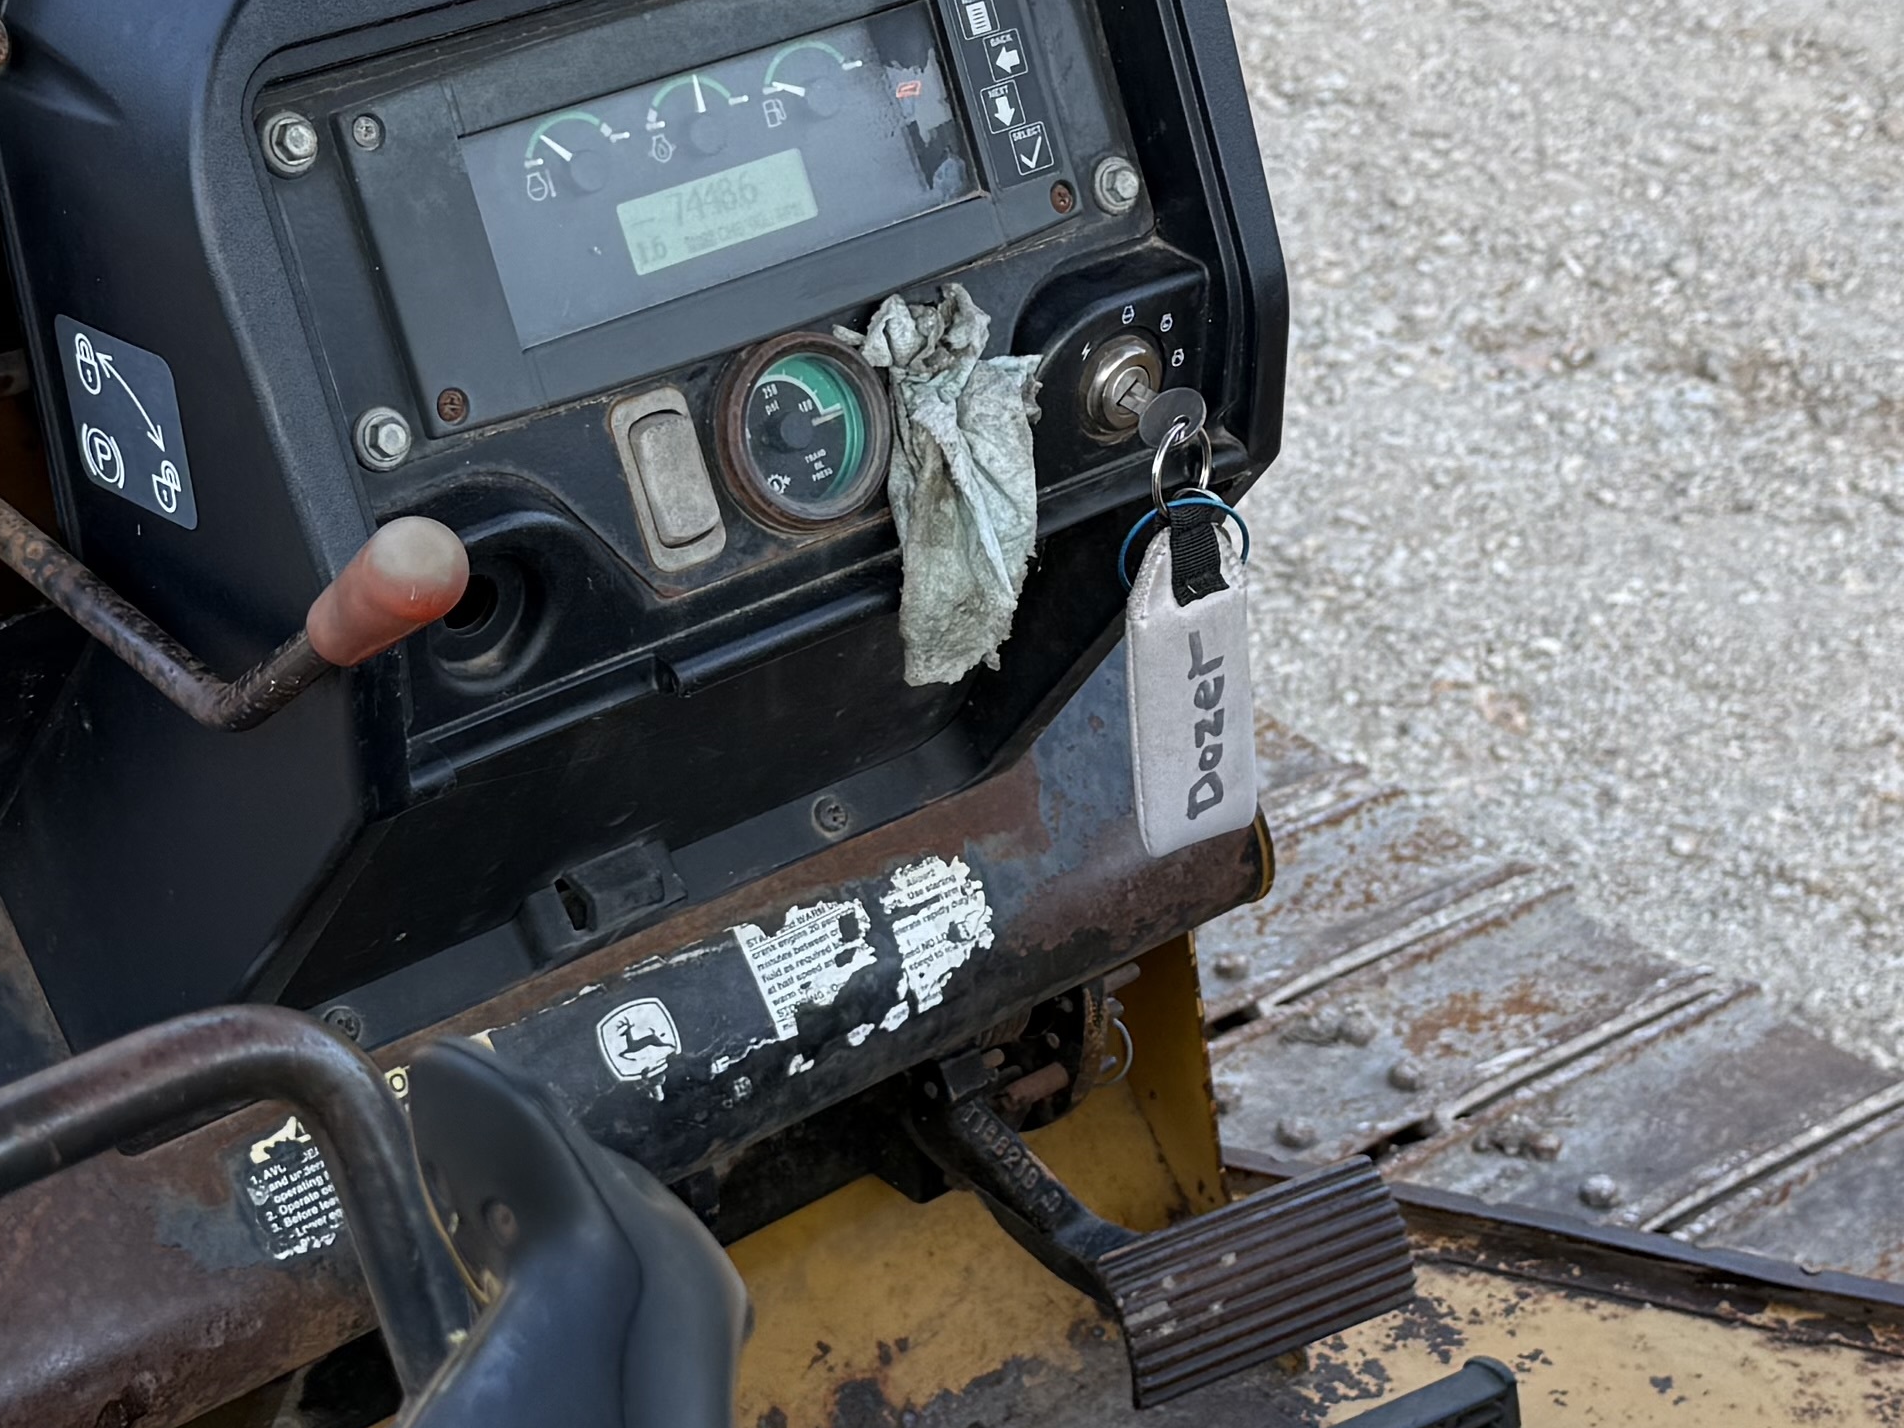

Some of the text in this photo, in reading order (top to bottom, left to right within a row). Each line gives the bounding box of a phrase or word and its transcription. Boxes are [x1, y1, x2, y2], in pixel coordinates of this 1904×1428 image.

[989, 33, 1013, 47] BACK
[987, 84, 1009, 99] NEXT
[1012, 124, 1042, 142] SELECT
[1186, 630, 1225, 821] Dozer
[269, 1176, 288, 1192] and
[274, 1176, 323, 1203] operating
[266, 1212, 277, 1221] 2.
[279, 1192, 319, 1215] Operate
[284, 1206, 318, 1227] Before
